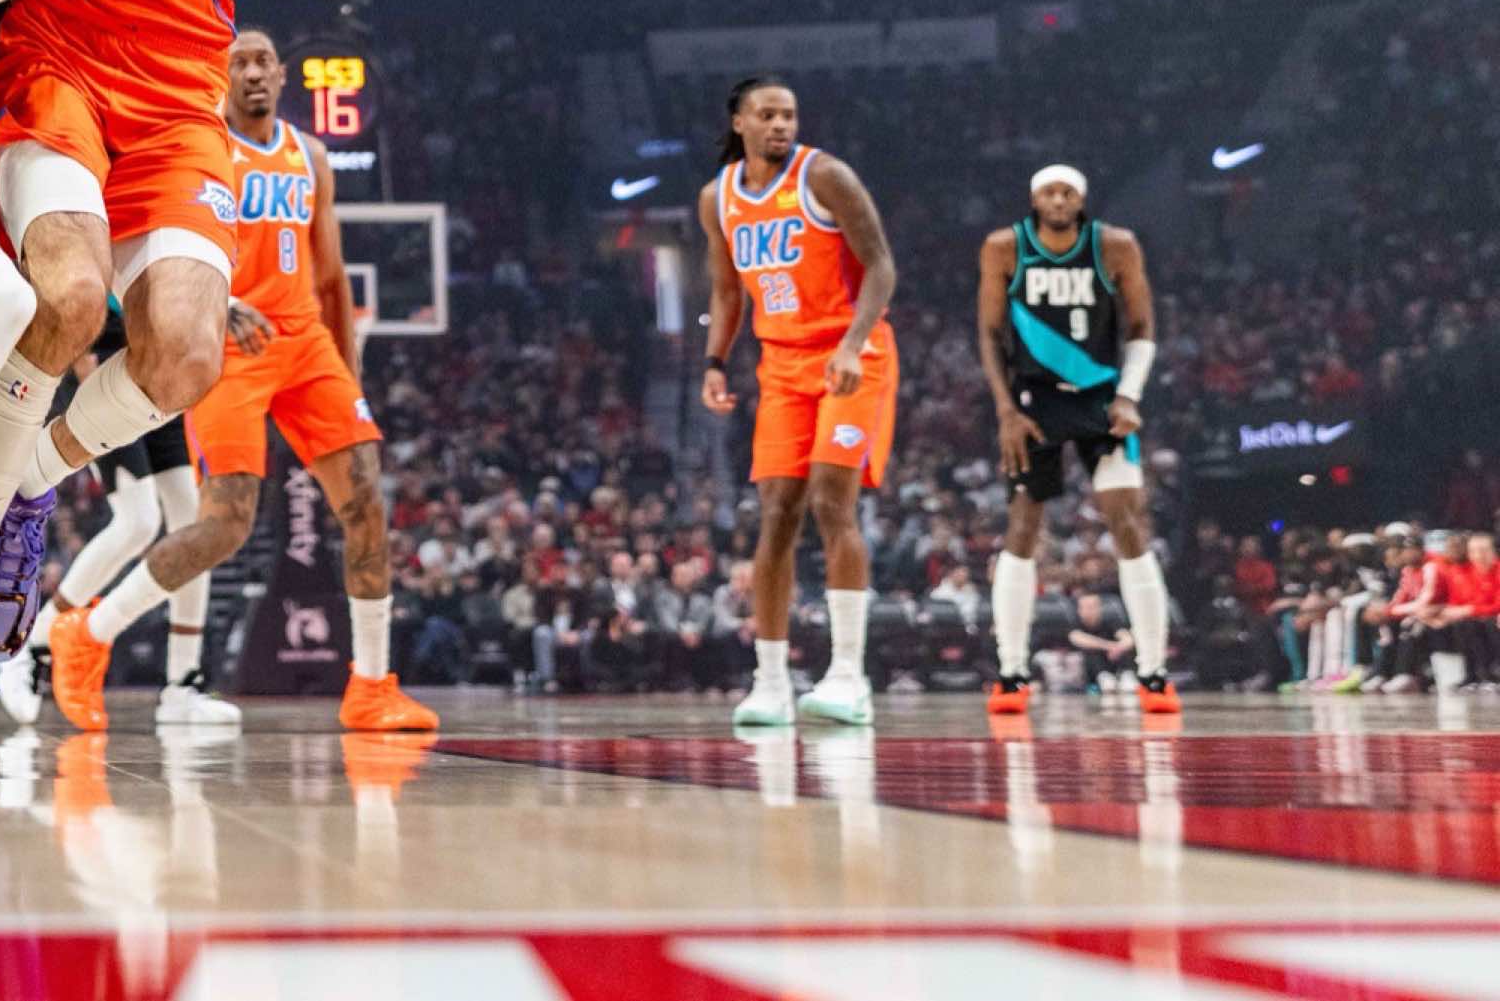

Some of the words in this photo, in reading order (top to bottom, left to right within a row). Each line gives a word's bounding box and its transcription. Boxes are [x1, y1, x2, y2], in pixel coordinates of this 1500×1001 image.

[313, 88, 360, 135] 16
[239, 170, 315, 224] OKC
[278, 229, 297, 274] 8
[733, 216, 804, 272] OKC
[758, 271, 801, 315] 22
[1025, 267, 1096, 306] PDX
[1069, 307, 1089, 342] 9
